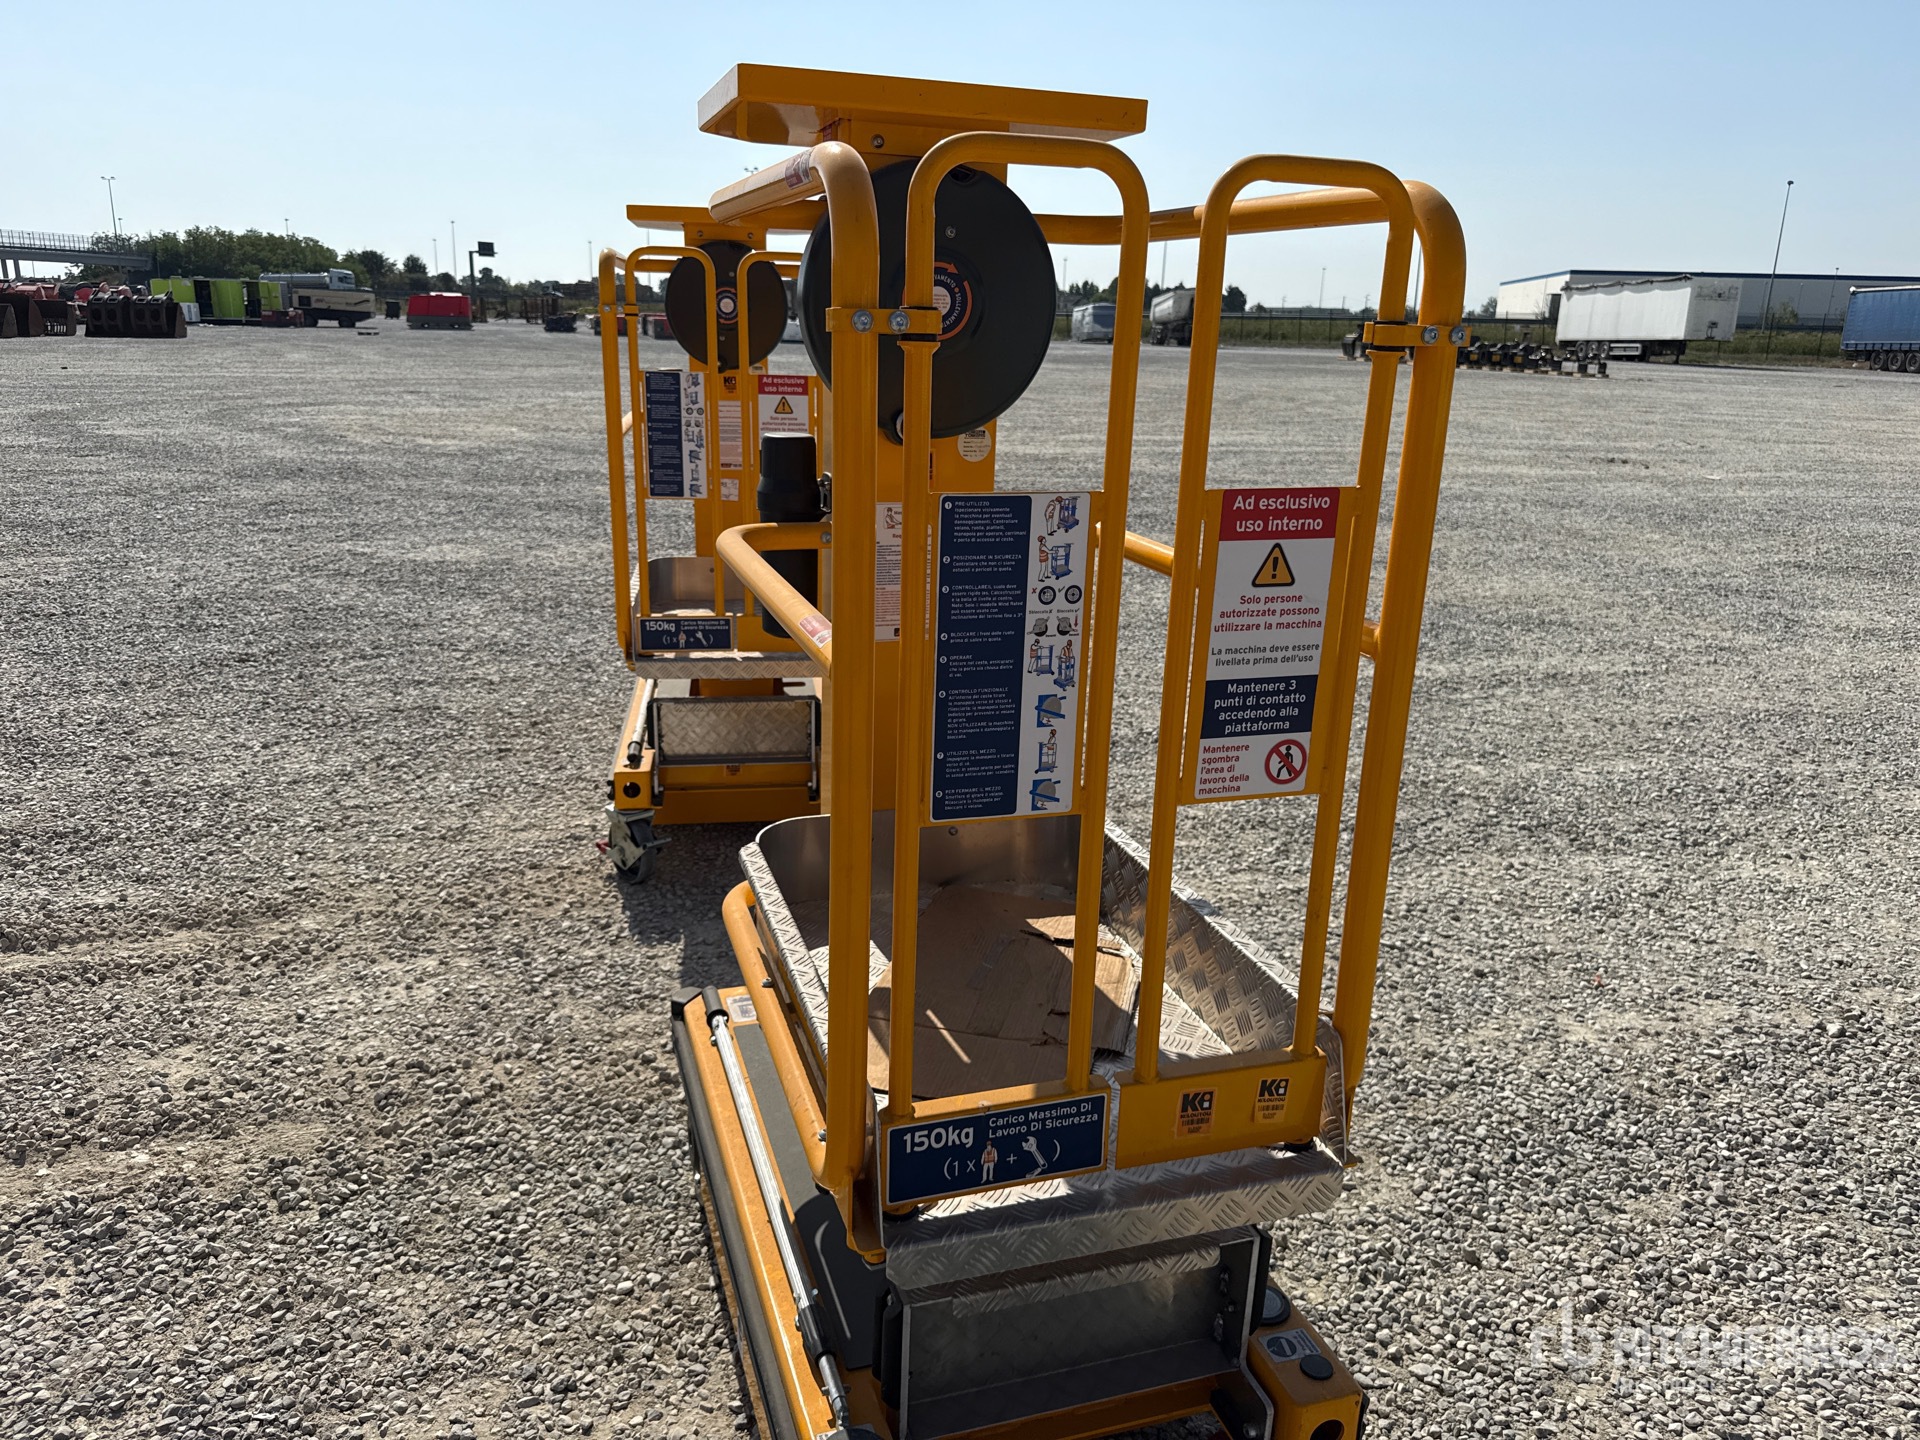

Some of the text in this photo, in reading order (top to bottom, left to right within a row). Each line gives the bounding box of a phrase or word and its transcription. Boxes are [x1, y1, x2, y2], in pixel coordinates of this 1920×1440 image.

[943, 293, 961, 327] SOLLEVAMENT
[1233, 494, 1331, 510] Ad esclusivo
[1236, 517, 1323, 532] uso interno
[1240, 594, 1303, 606] Solo persone
[1219, 607, 1320, 618] autorizzate possono
[645, 621, 676, 632] 150kg
[1214, 619, 1322, 633] utilizzare la macchina
[1211, 643, 1320, 656] La macchina deve essere
[1215, 653, 1313, 667] livellata prima dell'uso
[1227, 680, 1297, 694] Mantenere 3
[1214, 694, 1306, 710] punti di contatto
[1218, 706, 1299, 721] accedendo alla
[1224, 720, 1290, 735] piattaforma
[1202, 744, 1250, 754] Mantenere
[1201, 754, 1240, 766] sgombra
[1200, 764, 1235, 775] l'area di
[1199, 774, 1250, 785] lavoro della
[1198, 786, 1241, 796] macchina
[903, 1101, 1092, 1153] 150kg Carico Massimo Di
[988, 1112, 1098, 1139] Lavoro Di Sicurezza
